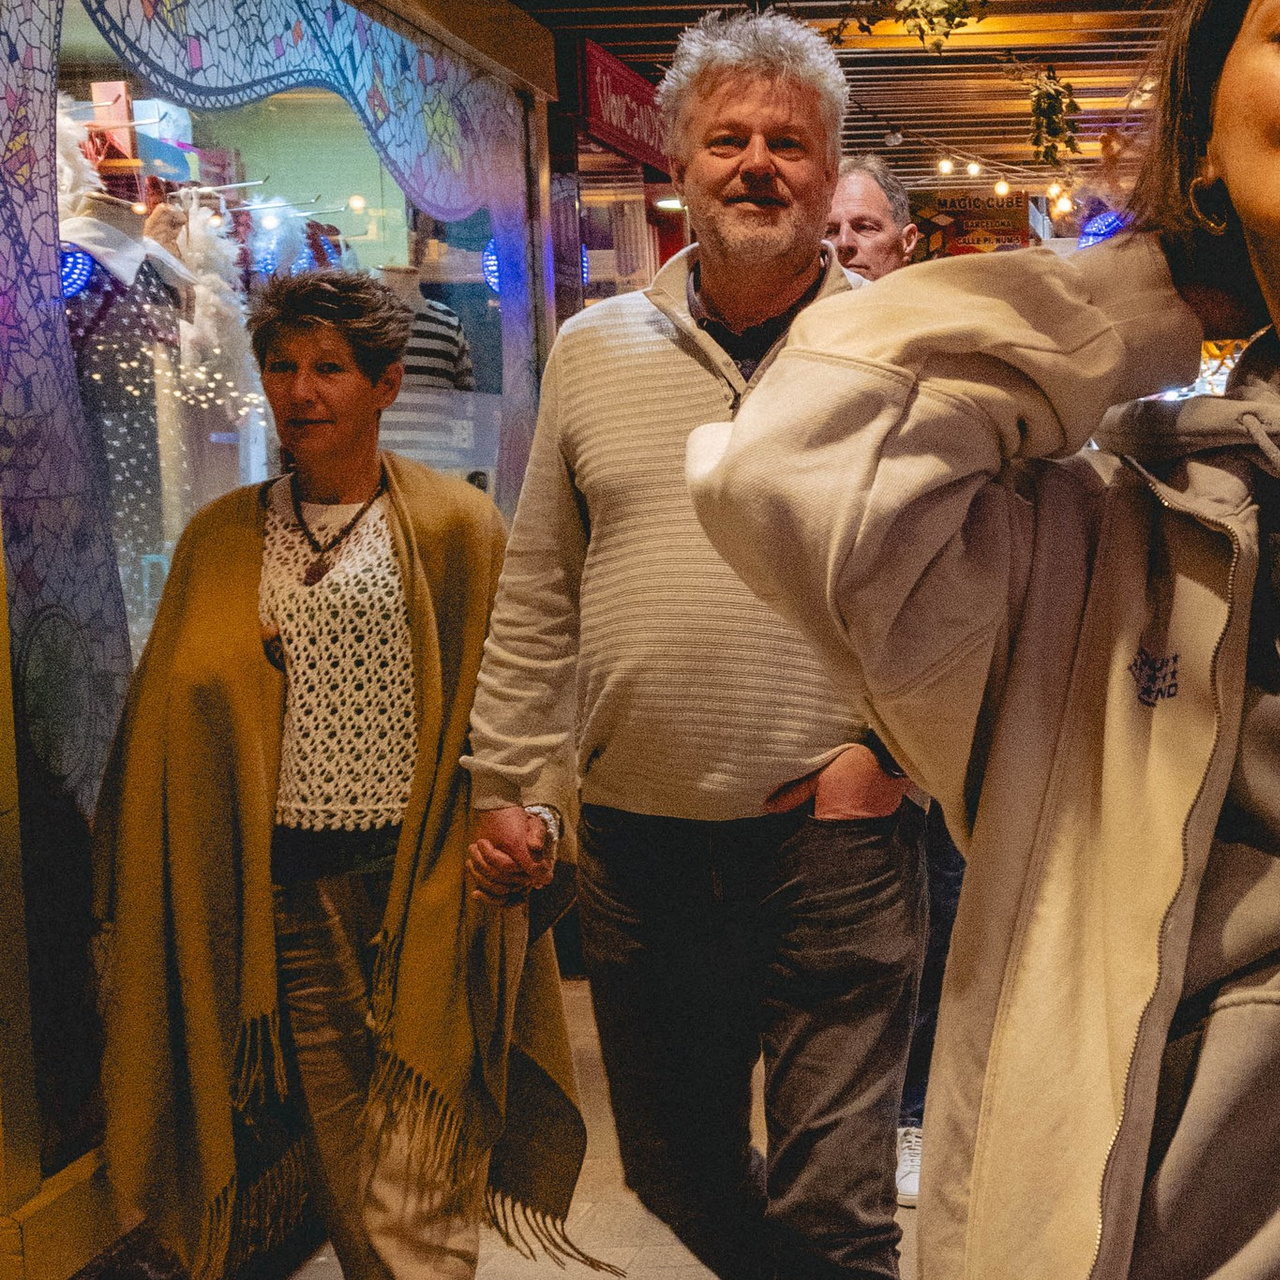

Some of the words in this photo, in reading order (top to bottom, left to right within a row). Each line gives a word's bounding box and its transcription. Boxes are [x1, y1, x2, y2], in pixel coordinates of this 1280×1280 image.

[937, 197, 981, 209] MAGIC
[986, 197, 1023, 209] CUBE
[964, 220, 1011, 229] BARCELONA
[957, 237, 981, 245] CALLE
